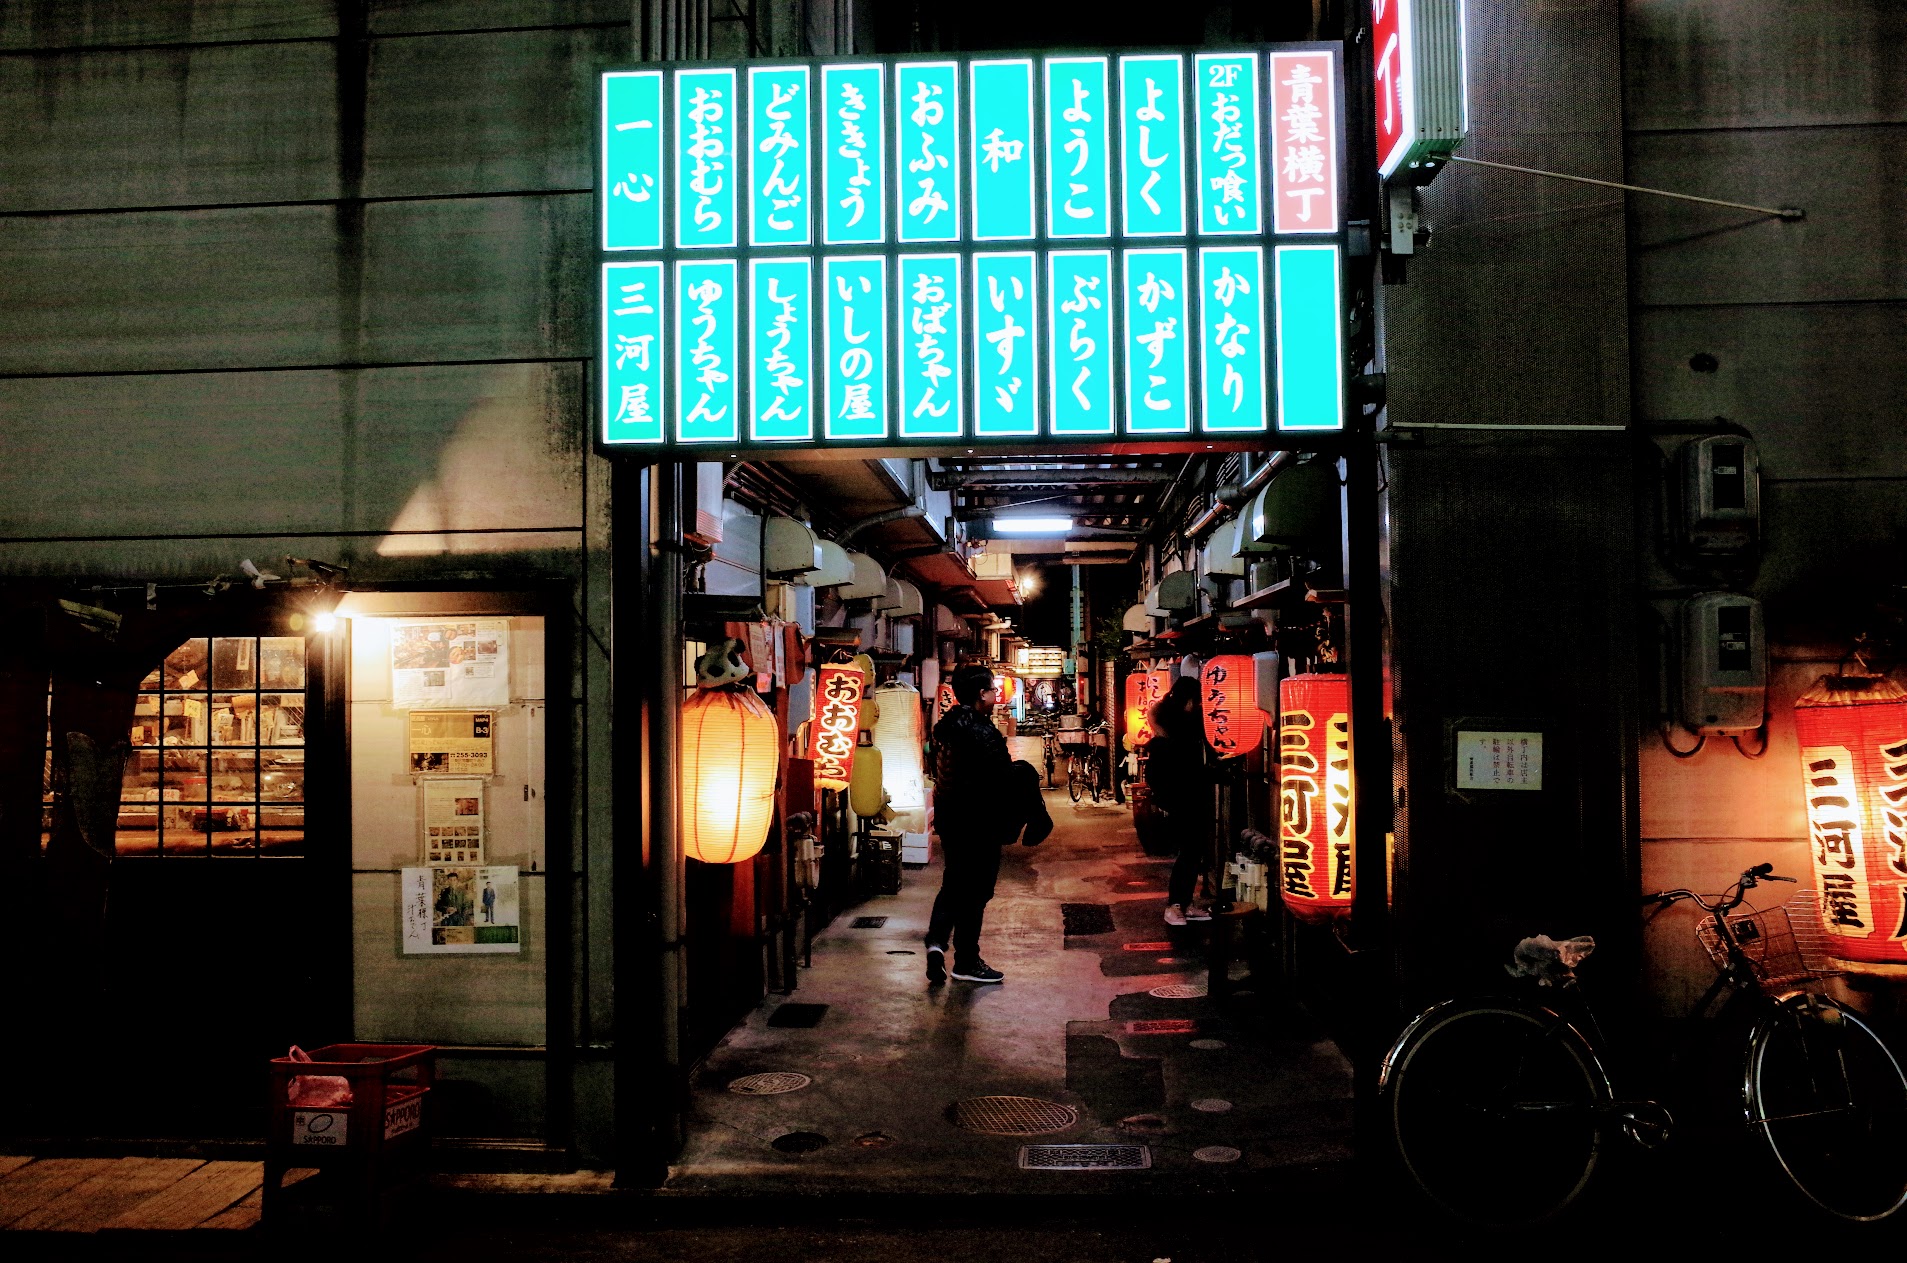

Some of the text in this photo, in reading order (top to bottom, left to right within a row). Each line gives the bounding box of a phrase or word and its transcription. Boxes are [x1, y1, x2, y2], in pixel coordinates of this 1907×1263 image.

[613, 120, 653, 202] 一心
[687, 87, 724, 232] おおむら
[759, 83, 801, 232] どみんご
[839, 83, 871, 227] ききょう
[909, 82, 948, 224] おふみ
[982, 128, 1024, 172] 和
[1063, 79, 1094, 218] ようこ
[1136, 78, 1168, 215] よしく
[1209, 65, 1247, 225] 2F おだっ喰い
[1280, 63, 1326, 223] 青葉横丁
[614, 282, 654, 423] 三河屋
[686, 280, 728, 422] ゆうちゃん
[761, 278, 803, 421] しょうちゃん
[836, 276, 875, 420] いしの屋
[911, 273, 953, 419] おばちゃん
[1061, 275, 1101, 410] ぶらく
[1136, 272, 1177, 410] かずこ
[1213, 267, 1250, 412] かなり
[1206, 665, 1236, 749] ゆうちゃん
[1808, 758, 1865, 929] 三河屋
